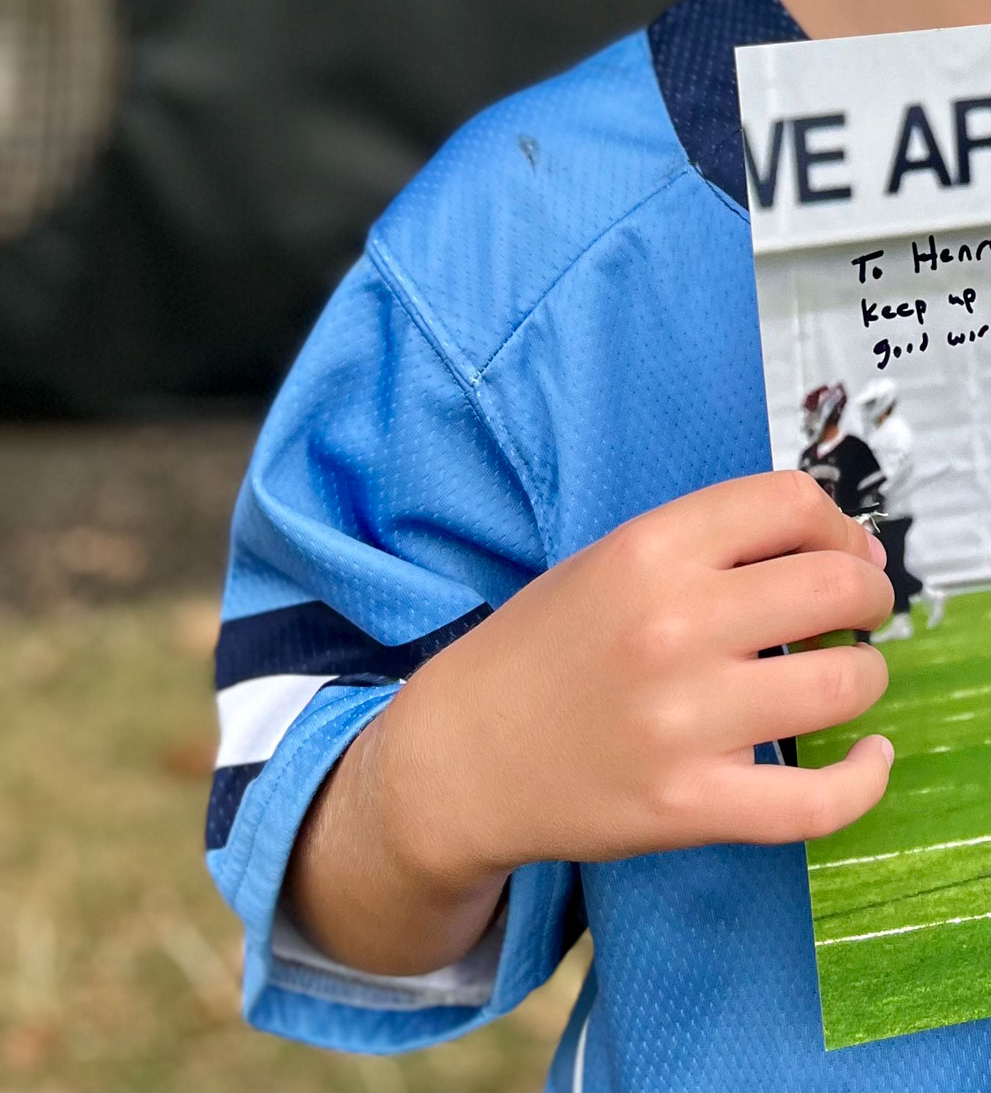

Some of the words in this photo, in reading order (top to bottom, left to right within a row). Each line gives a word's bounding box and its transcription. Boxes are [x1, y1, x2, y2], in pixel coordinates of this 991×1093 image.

[851, 249, 885, 284] To
[948, 287, 977, 314] up
[873, 332, 929, 370] good
